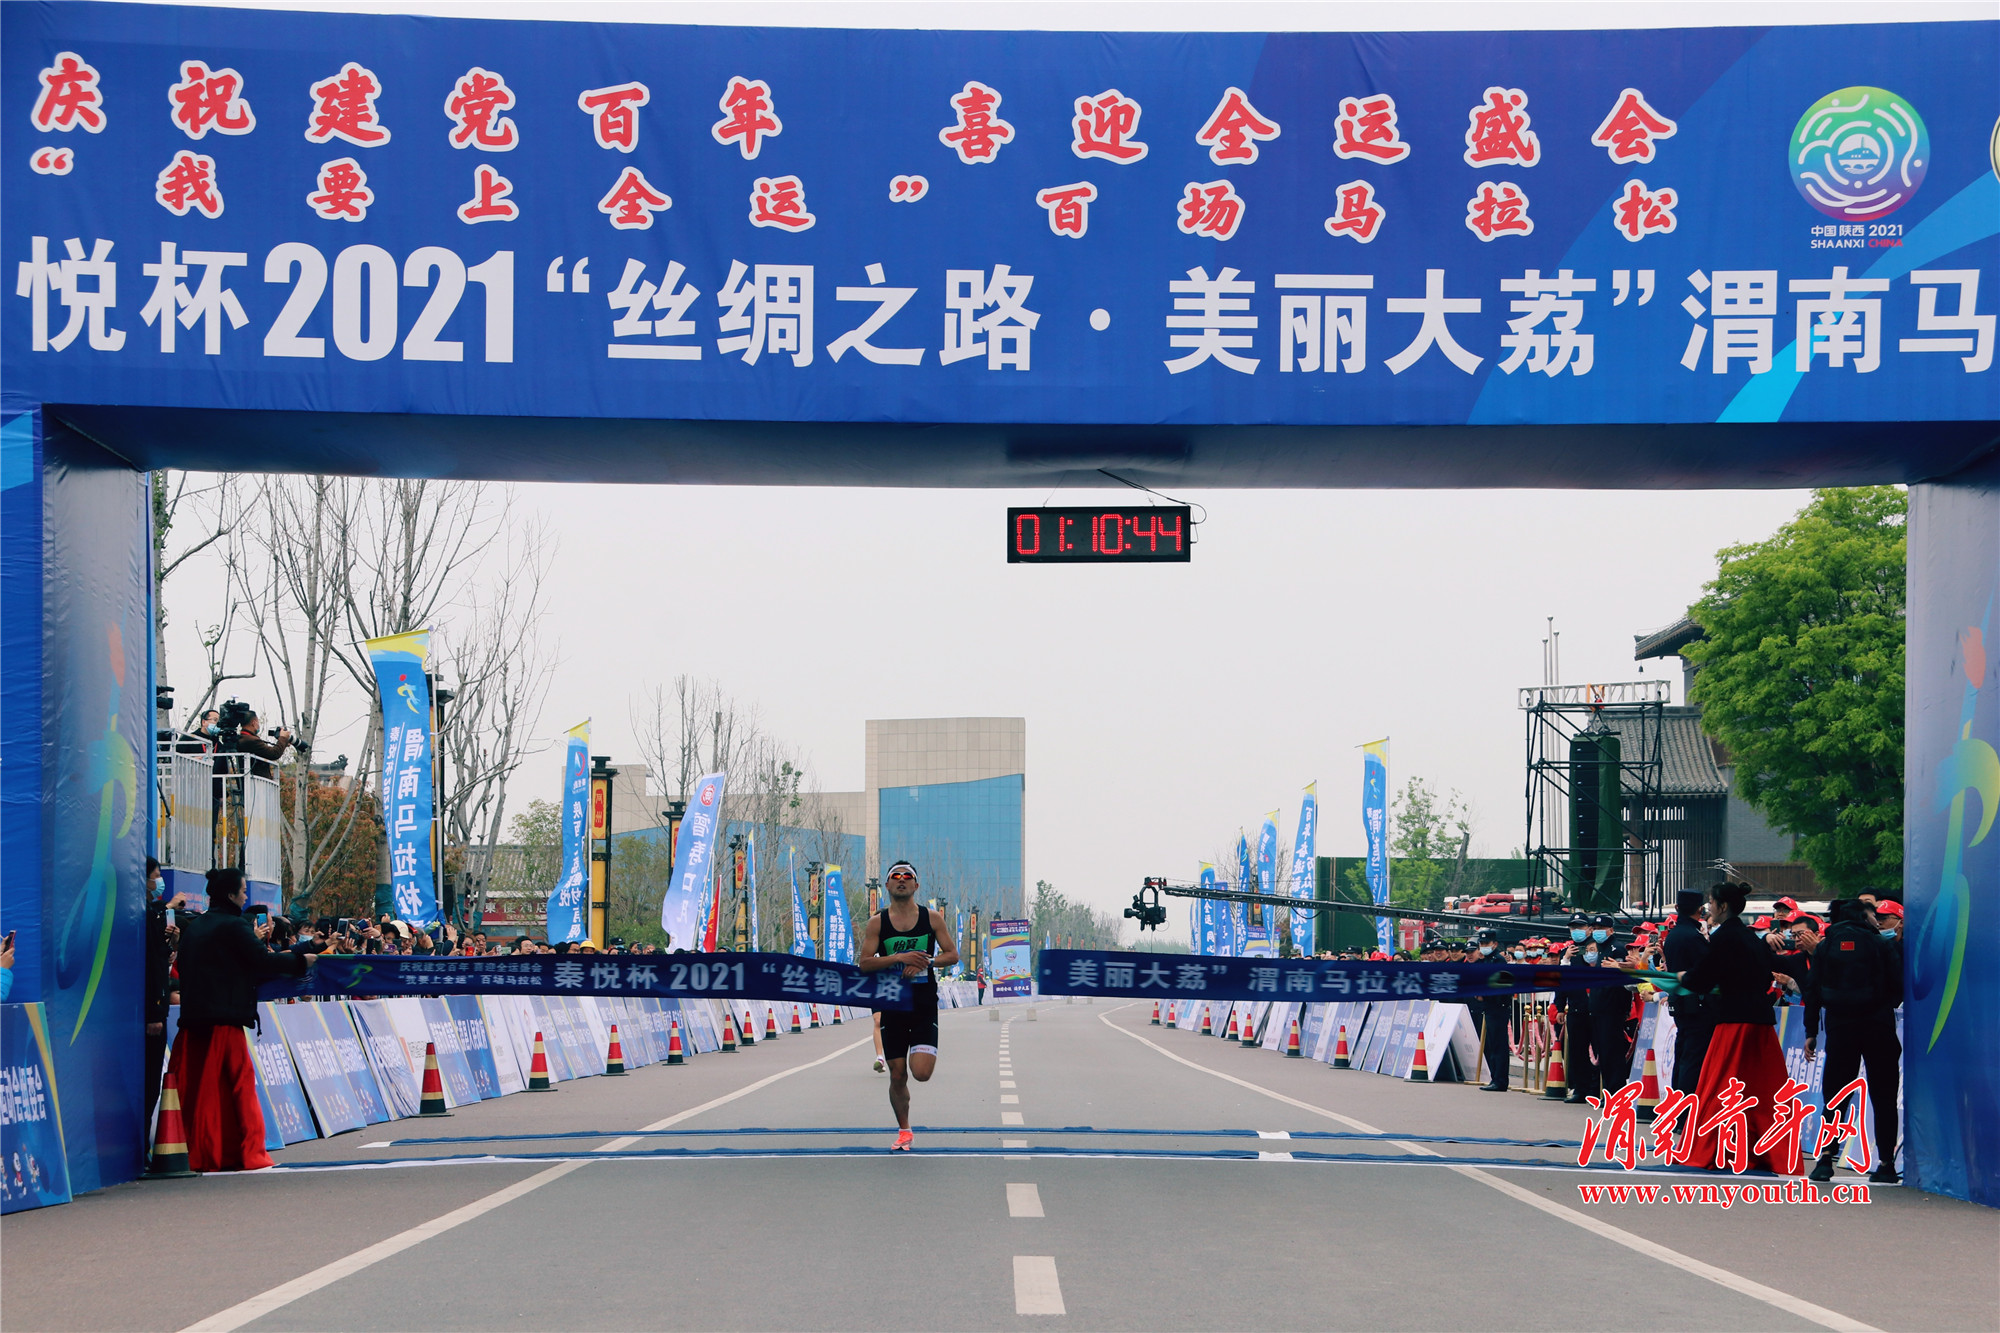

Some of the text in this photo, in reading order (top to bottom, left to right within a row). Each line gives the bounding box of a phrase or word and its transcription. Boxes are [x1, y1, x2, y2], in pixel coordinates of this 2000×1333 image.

[31, 52, 1678, 167] 庆祝建党百年 喜迎全运盛会
[1811, 224, 1903, 236] 中国 陕西 2021
[1810, 239, 1903, 249] SHAANXI CHINA
[1016, 513, 1182, 555] 01:10:44
